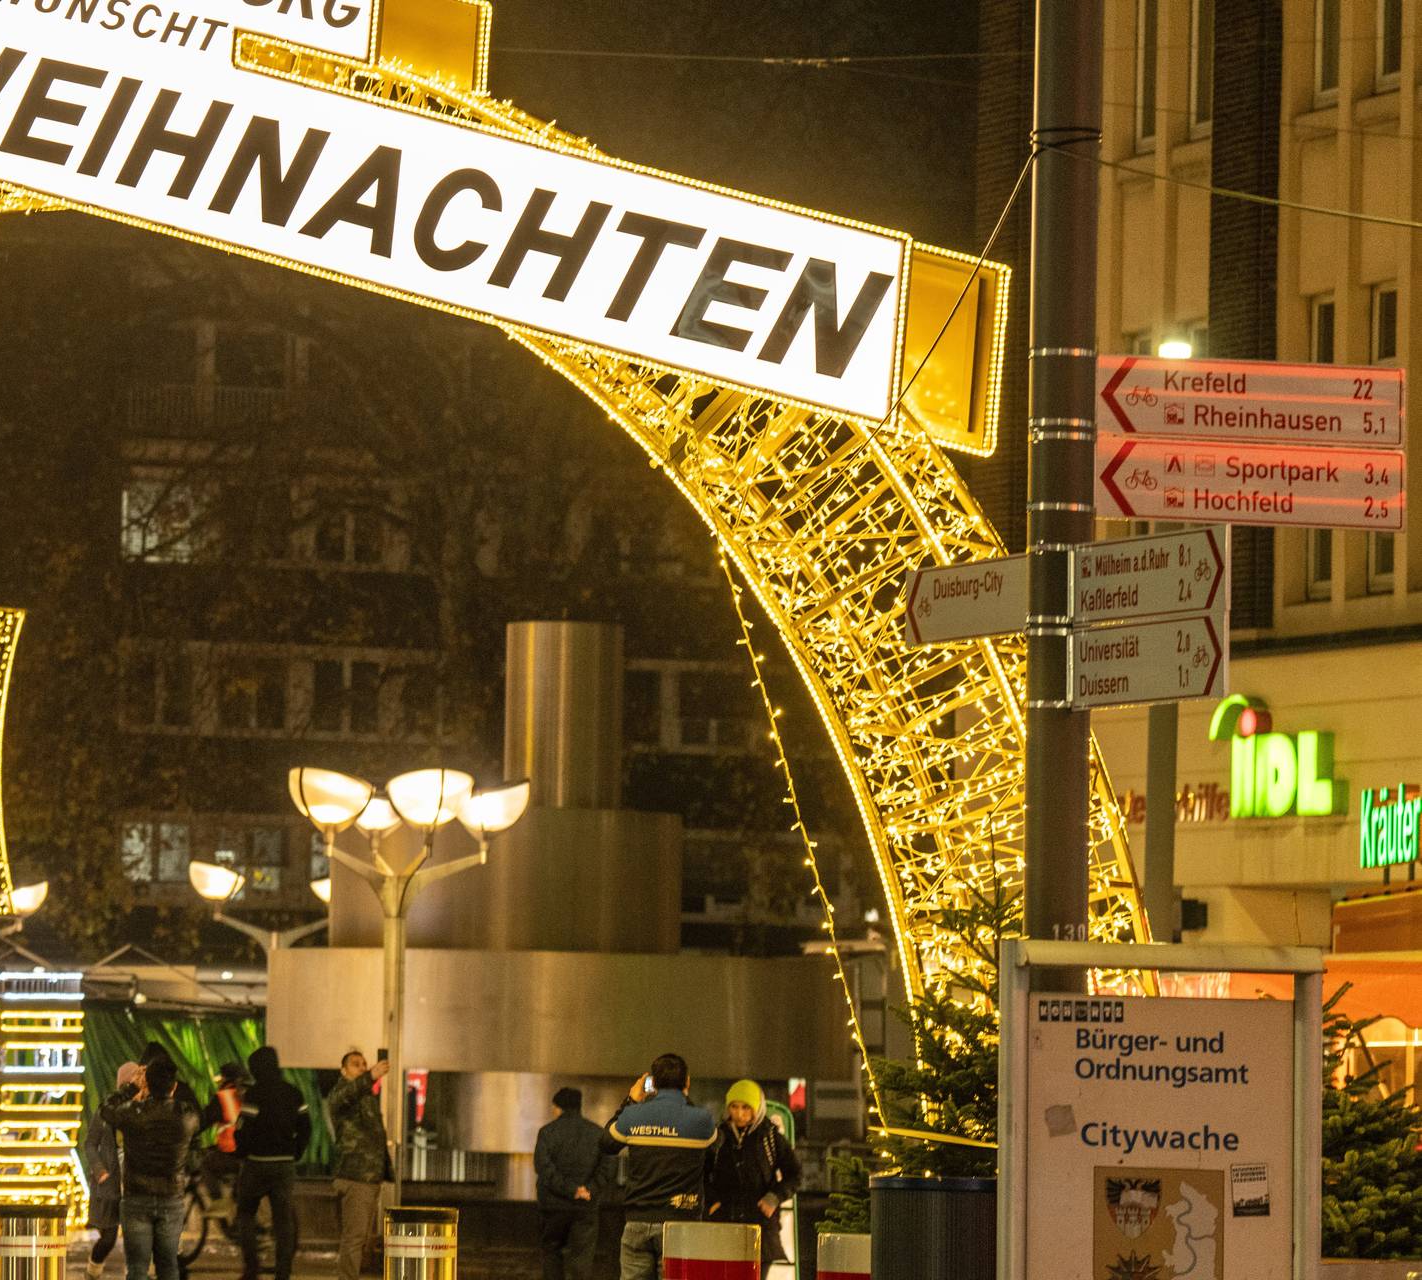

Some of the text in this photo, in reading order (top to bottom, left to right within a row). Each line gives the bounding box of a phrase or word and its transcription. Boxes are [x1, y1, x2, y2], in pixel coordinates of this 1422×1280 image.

[1164, 371, 1373, 400] Krefeld 22
[1194, 405, 1386, 434] Rheinhausen 5,1
[1226, 457, 1389, 486] Sportpark 3,4
[1194, 488, 1389, 519] Hochfeld 2,5
[1095, 554, 1129, 577] Mülheim
[1179, 544, 1191, 567] 8,1
[933, 572, 1004, 600] Duisburg-City
[1080, 586, 1138, 610] Kaßlerfeld
[1080, 637, 1139, 662] Universität
[1080, 674, 1128, 697] Duissern
[1360, 783, 1421, 869] Kräuter
[1076, 1028, 1224, 1056] Bürger- und
[1075, 1058, 1249, 1088] Ordnungsamt
[630, 1126, 679, 1137] WESTHILL
[1080, 1122, 1239, 1154] Citywache
